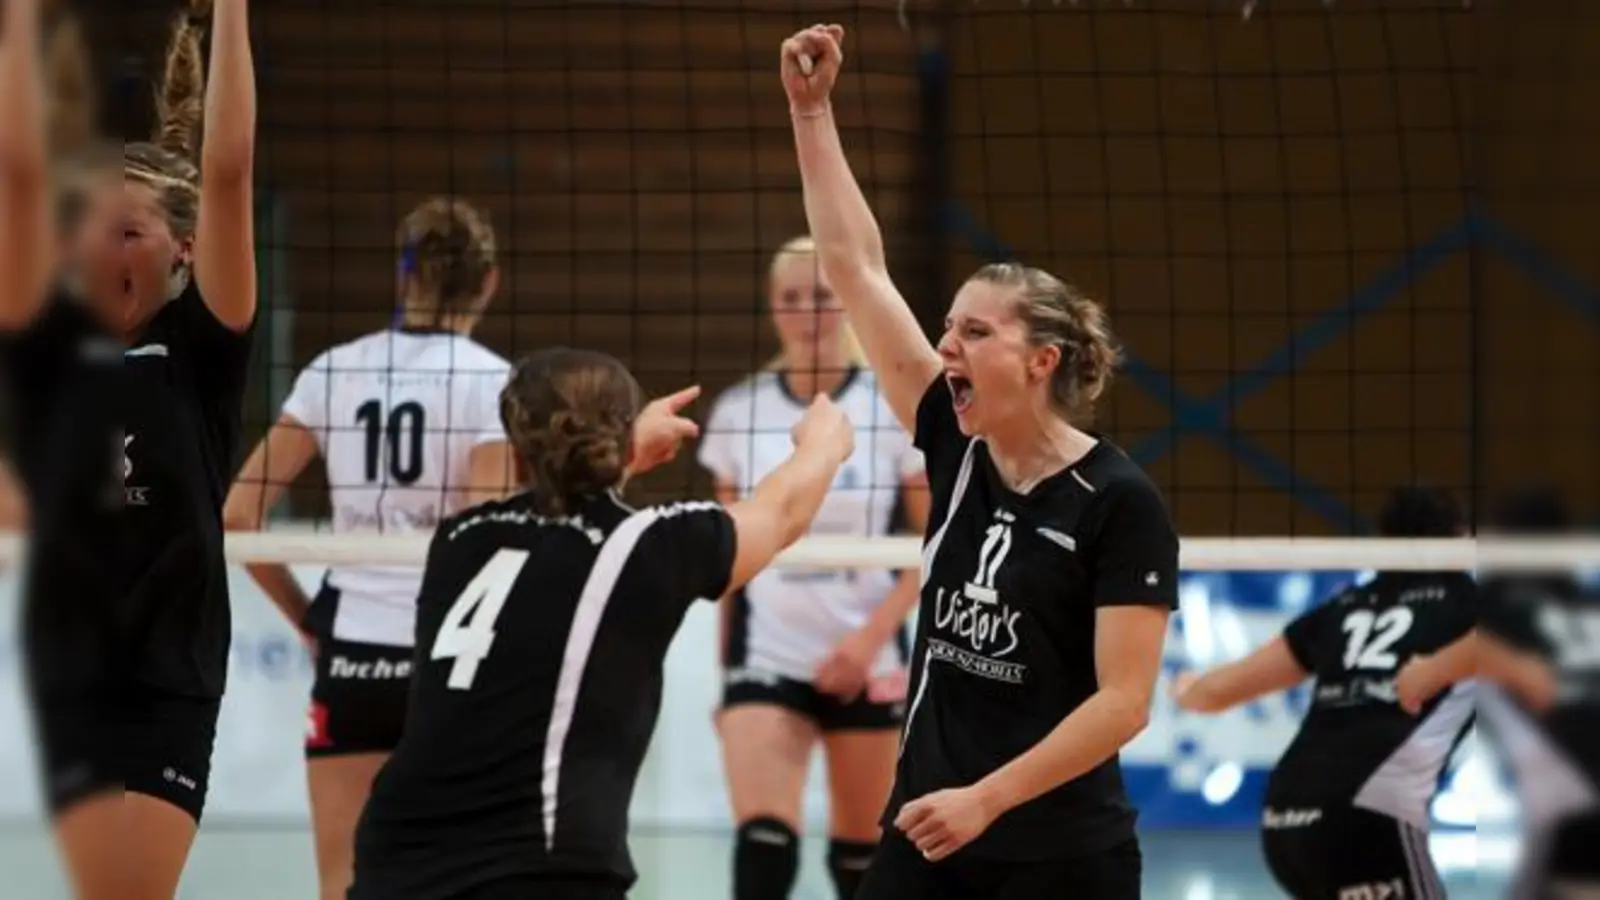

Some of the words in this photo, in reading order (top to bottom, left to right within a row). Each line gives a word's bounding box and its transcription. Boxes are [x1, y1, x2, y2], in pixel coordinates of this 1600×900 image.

[355, 398, 425, 485] 10
[430, 547, 531, 690] 4
[935, 587, 1021, 657] Victor's
[1341, 605, 1413, 671] 12
